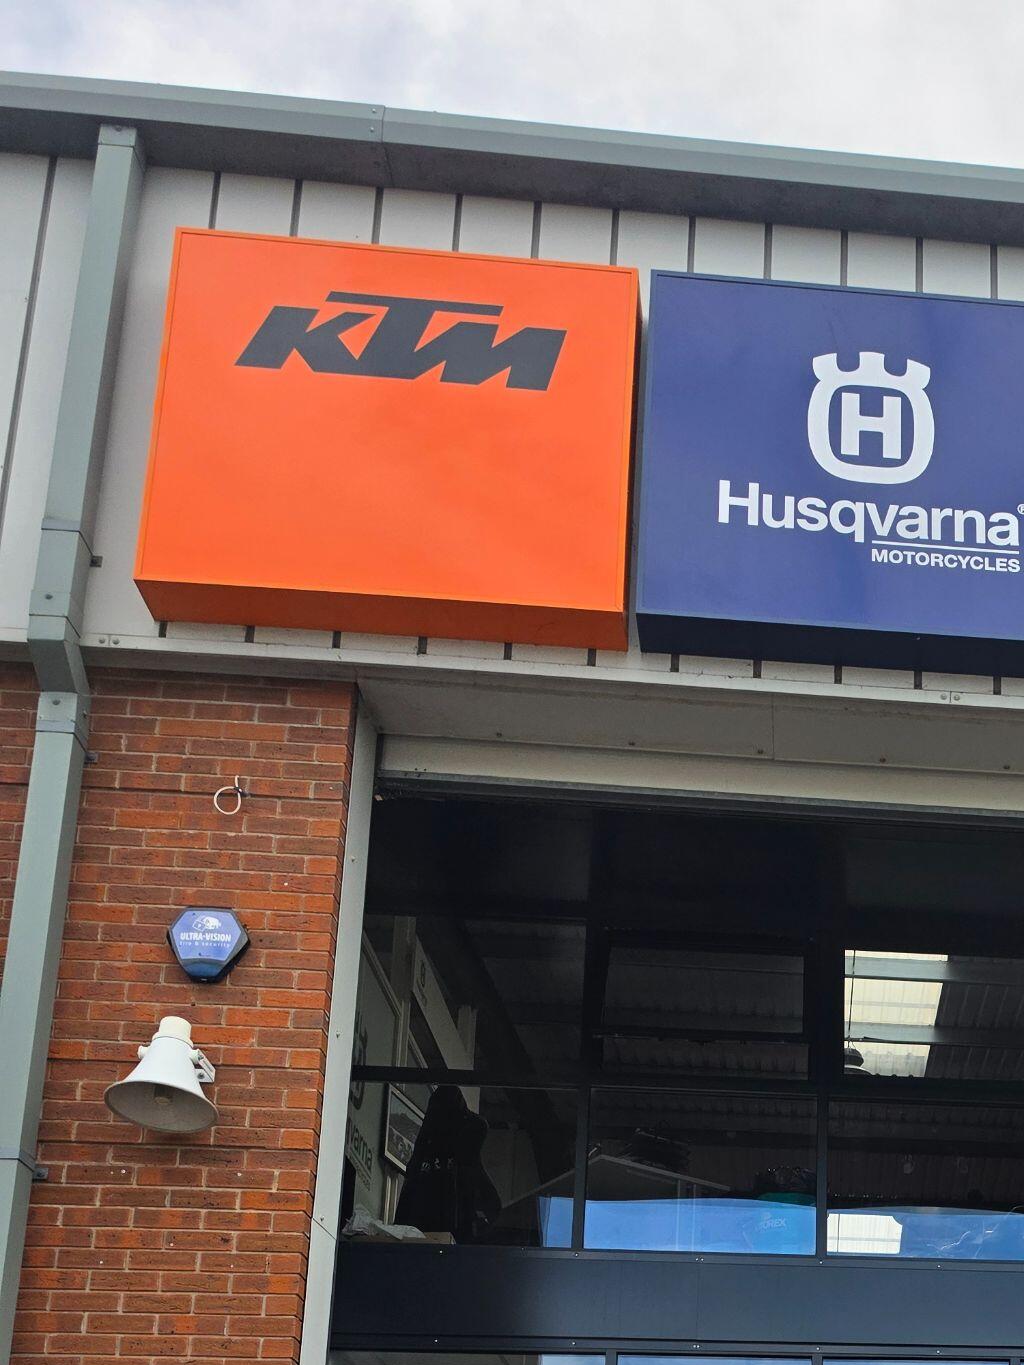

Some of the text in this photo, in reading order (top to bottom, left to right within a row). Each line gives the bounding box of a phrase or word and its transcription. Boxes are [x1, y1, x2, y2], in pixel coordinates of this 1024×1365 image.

[235, 291, 567, 391] KTM
[871, 548, 1021, 573] MOTORCYCLES
[180, 931, 232, 942] ULTRA-VISION
